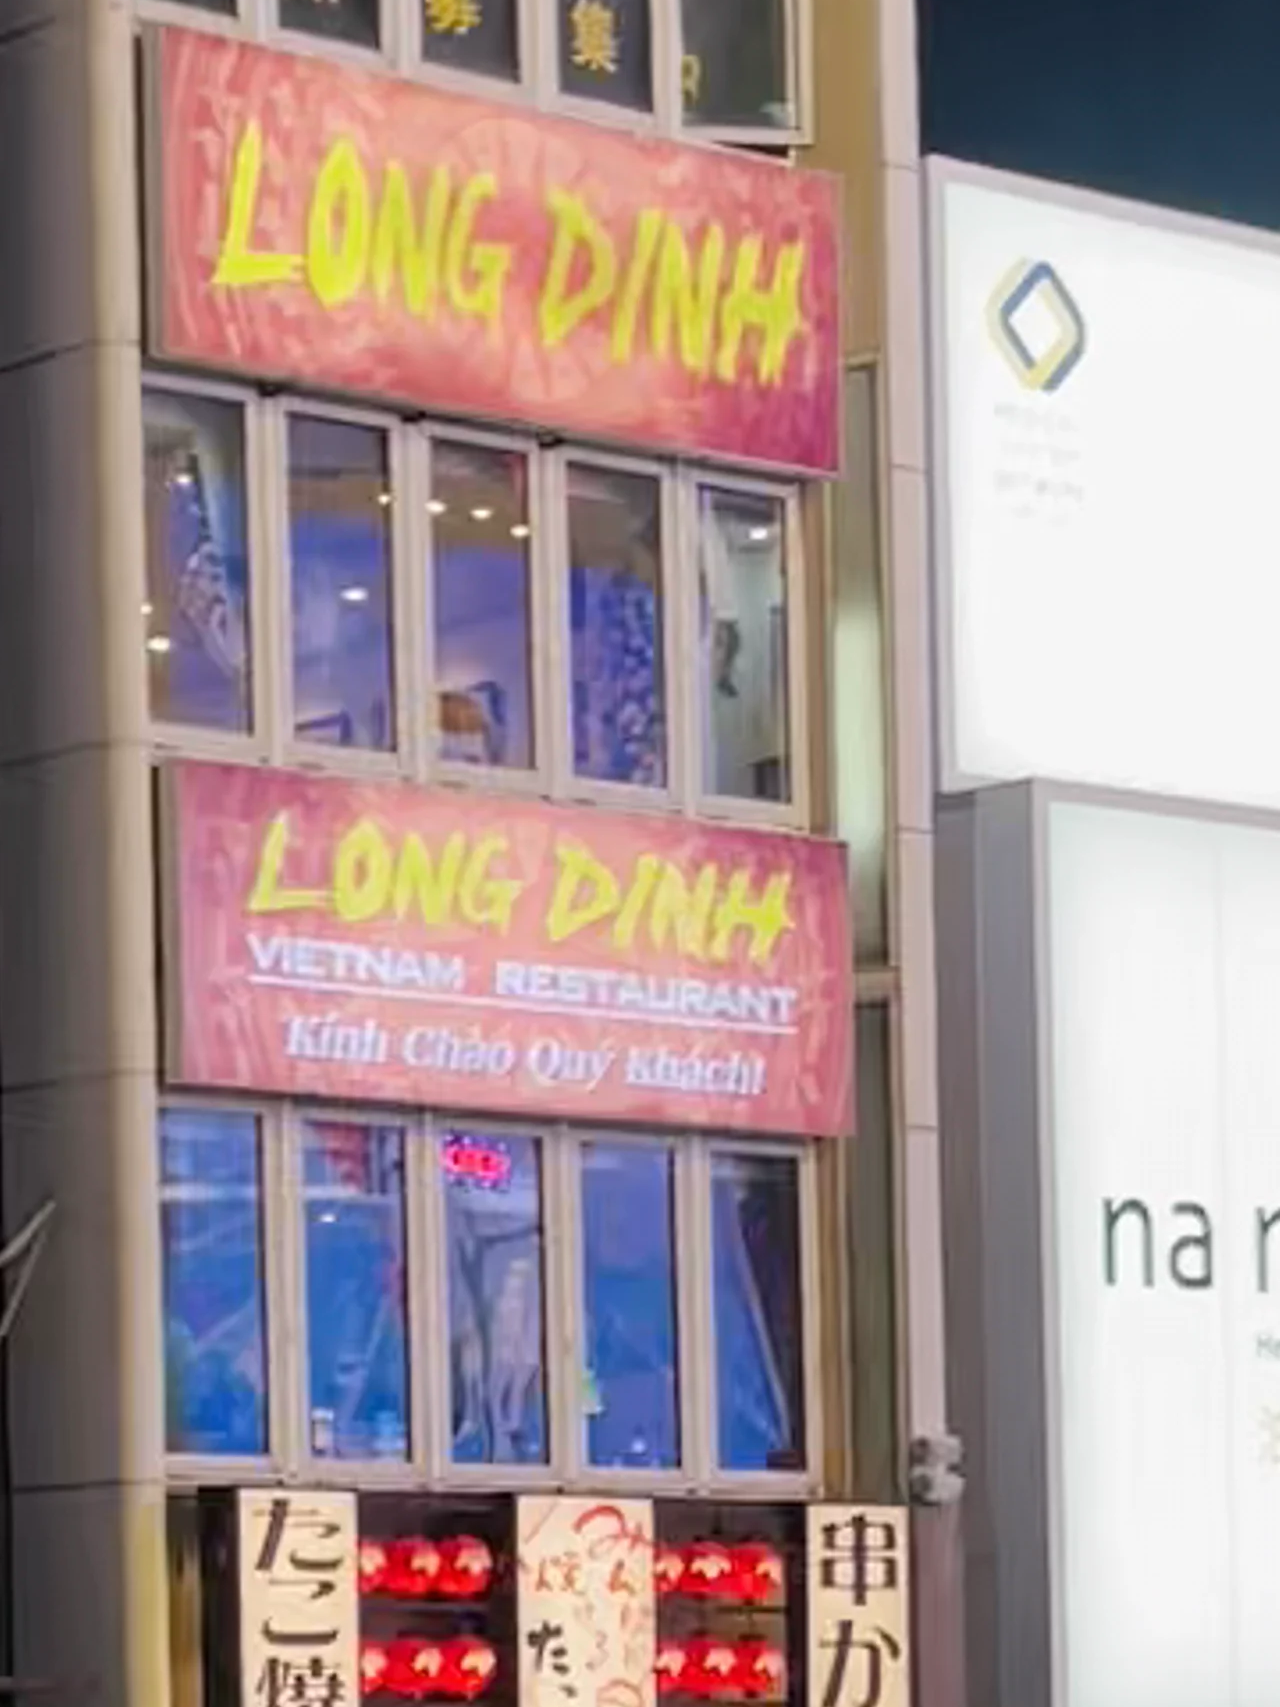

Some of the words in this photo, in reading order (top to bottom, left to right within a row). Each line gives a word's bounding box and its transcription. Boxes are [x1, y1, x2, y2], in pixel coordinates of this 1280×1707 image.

[212, 118, 515, 349] LONG
[538, 185, 809, 387] DINH
[246, 809, 524, 935] LONG
[546, 839, 795, 966] DINH
[246, 932, 466, 991] VIETNAM
[495, 959, 797, 1024] RESTAURANT
